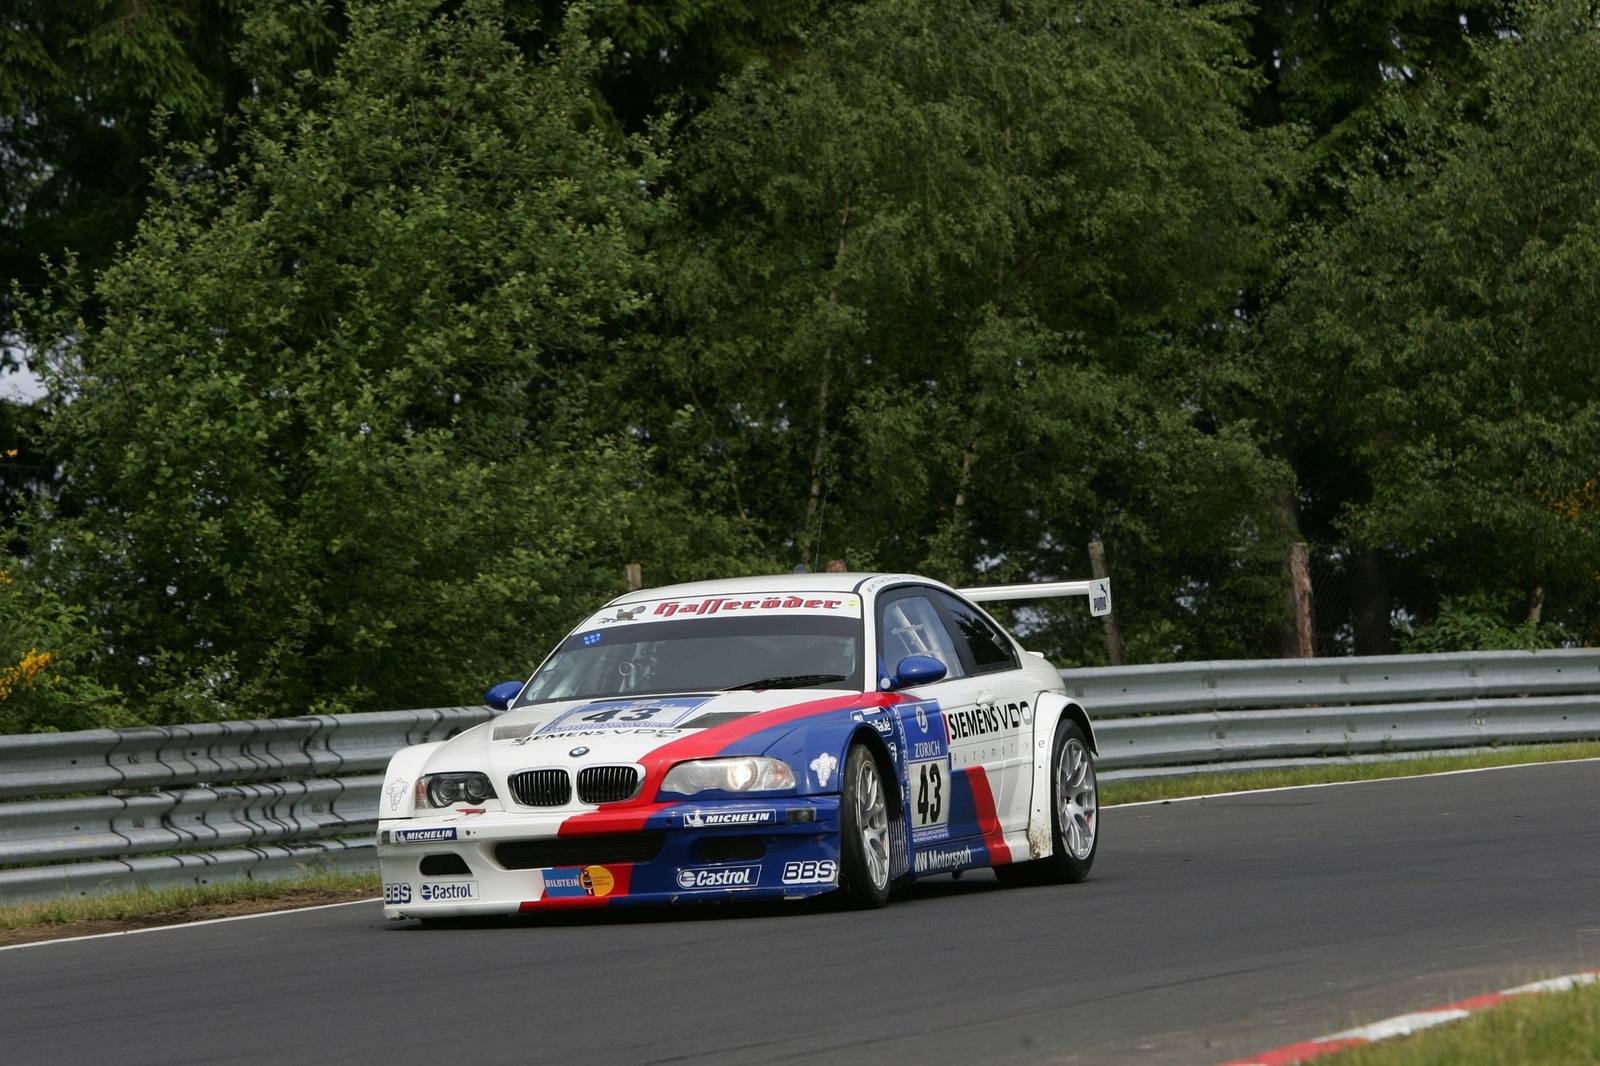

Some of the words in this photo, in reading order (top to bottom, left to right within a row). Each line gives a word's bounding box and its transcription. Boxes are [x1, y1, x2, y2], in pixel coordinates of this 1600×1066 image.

[581, 707, 662, 723] 43
[948, 706, 999, 740] SIEMENS
[996, 701, 1032, 730] VDO
[917, 763, 942, 825] 43
[705, 812, 770, 824] MICHELIN
[406, 829, 453, 840] MICHELIN
[928, 846, 972, 870] Motorsport
[696, 869, 749, 887] Castrol
[783, 861, 836, 884] BBS
[432, 884, 472, 899] Castrol
[545, 878, 579, 888] BILSTEIN
[384, 883, 412, 904] BBS
